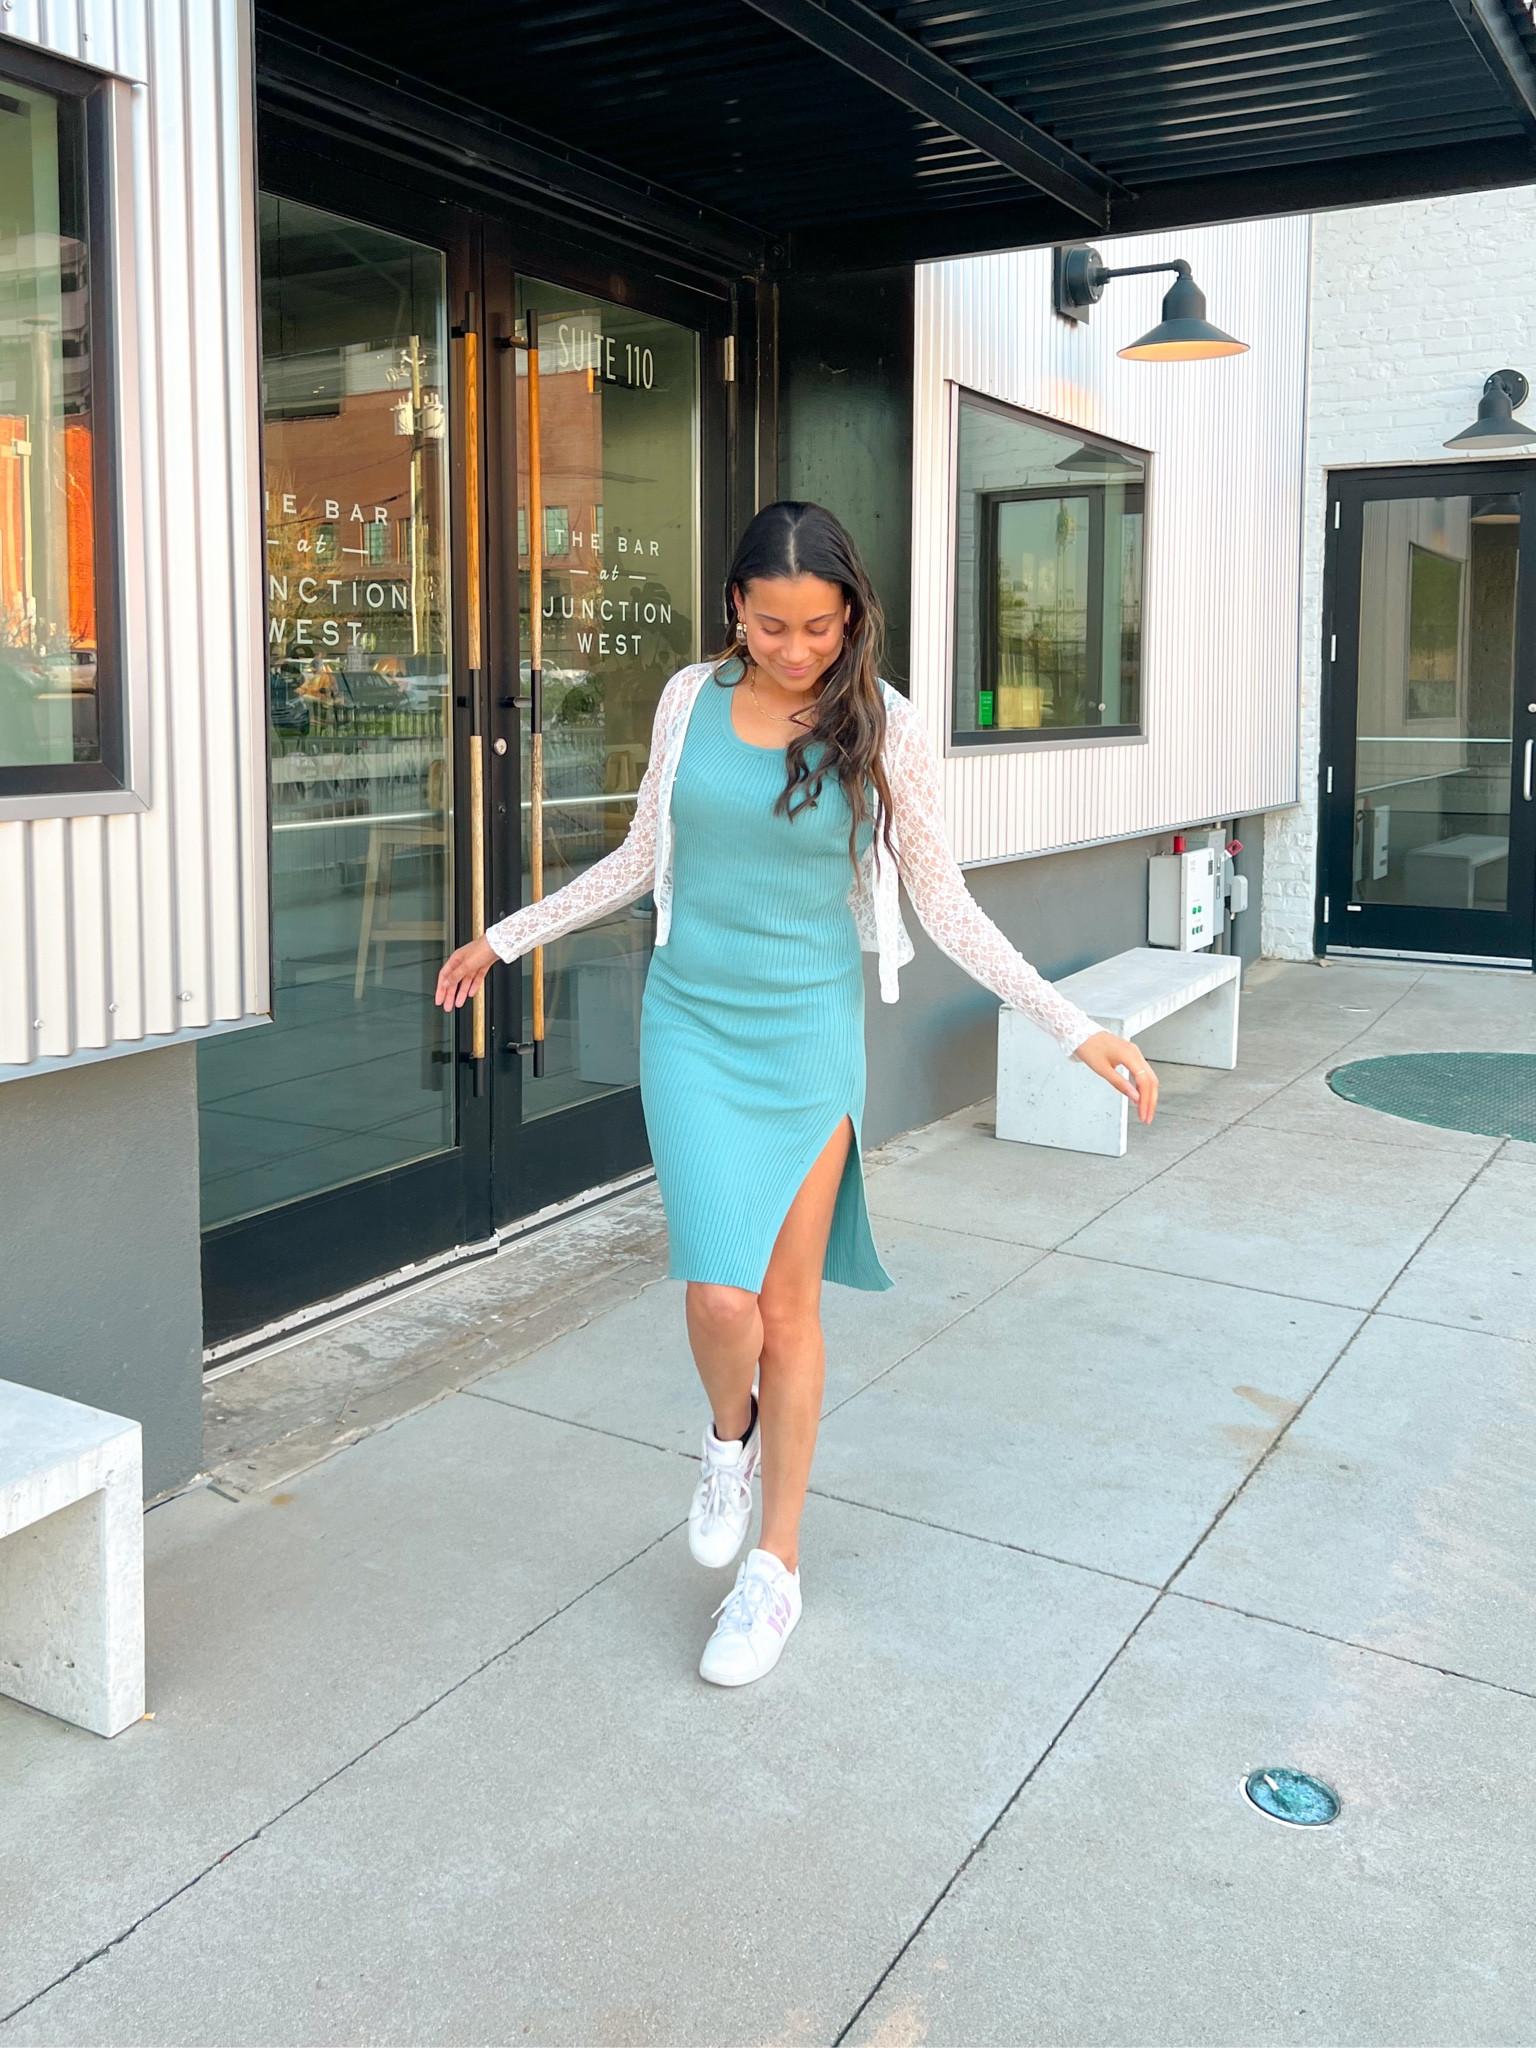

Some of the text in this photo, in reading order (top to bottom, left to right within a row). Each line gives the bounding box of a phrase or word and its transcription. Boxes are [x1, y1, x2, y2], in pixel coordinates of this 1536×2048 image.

[559, 324, 653, 389] SUITE 110
[325, 499, 388, 525] BAR
[297, 534, 327, 554] at
[555, 529, 659, 556] THE BAR
[600, 565, 620, 581] at
[269, 575, 407, 609] NCTION
[543, 596, 671, 624] JUNCTION
[269, 617, 362, 646] WEST
[577, 632, 642, 655] WEST
